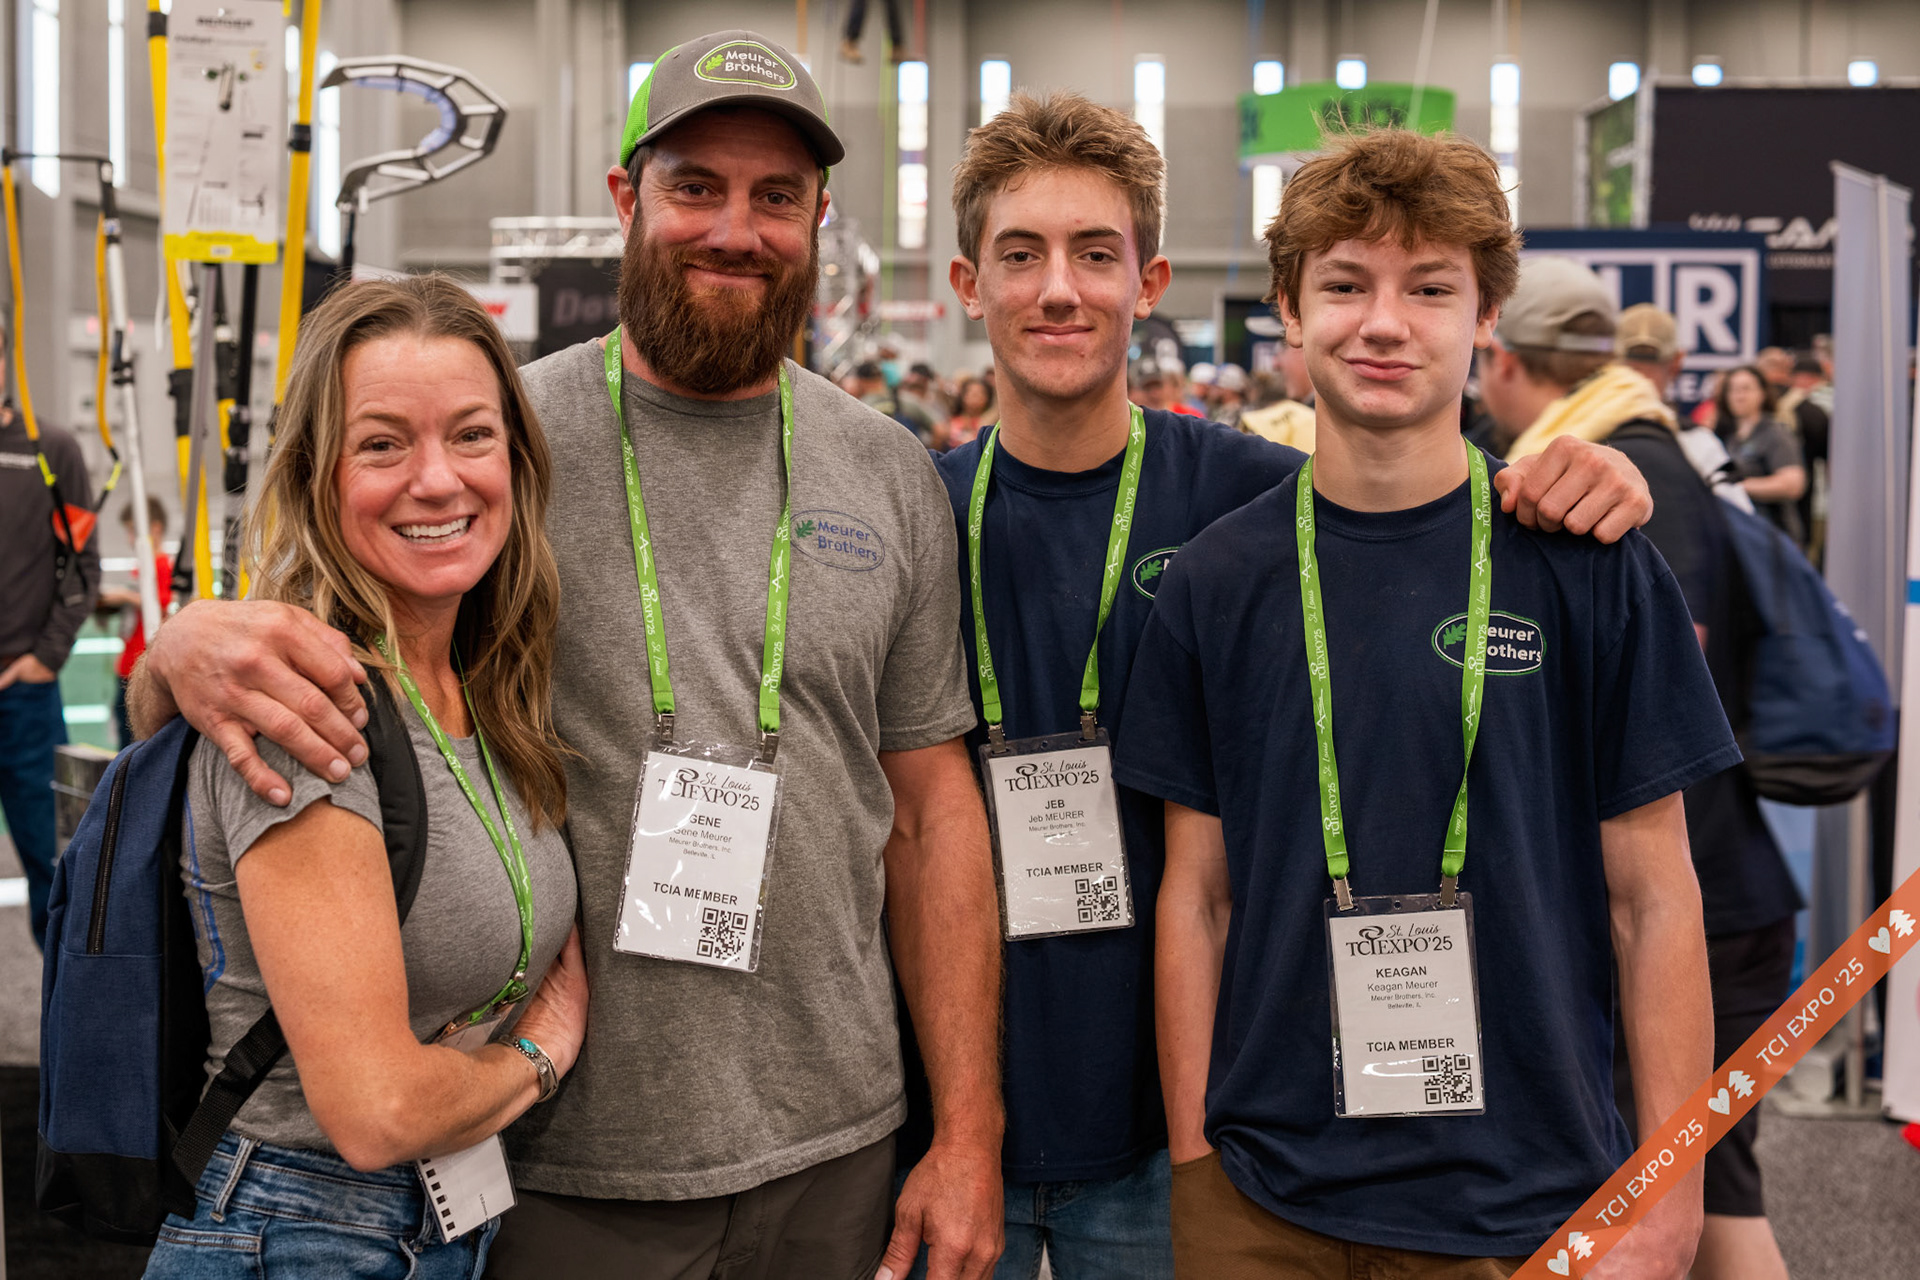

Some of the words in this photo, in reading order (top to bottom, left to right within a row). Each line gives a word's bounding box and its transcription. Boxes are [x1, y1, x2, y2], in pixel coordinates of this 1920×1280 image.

[725, 51, 778, 69] Meurer
[725, 62, 785, 84] Brothers
[818, 520, 870, 541] Meurer
[818, 535, 878, 561] Brothers
[1487, 626, 1535, 642] eurer
[1487, 644, 1542, 662] others
[1059, 759, 1087, 772] Louis
[721, 775, 752, 792] Louis
[1045, 799, 1065, 809] JEB
[689, 814, 722, 828] GENE
[1028, 814, 1043, 823] Jeb
[1045, 810, 1085, 821] MEURER
[673, 826, 698, 838] Gene
[700, 830, 733, 843] Meurer
[1026, 867, 1052, 878] TCIA
[1055, 862, 1104, 876] MEMBER
[653, 882, 681, 897] TCIA
[684, 887, 738, 905] MEMBER
[1408, 923, 1440, 937] Louis
[1375, 966, 1427, 978] KEAGAN
[1367, 982, 1403, 993] Keagan
[1405, 980, 1438, 990] Meurer
[1366, 1041, 1396, 1052] TCIA
[1399, 1037, 1455, 1051] MEMBER
